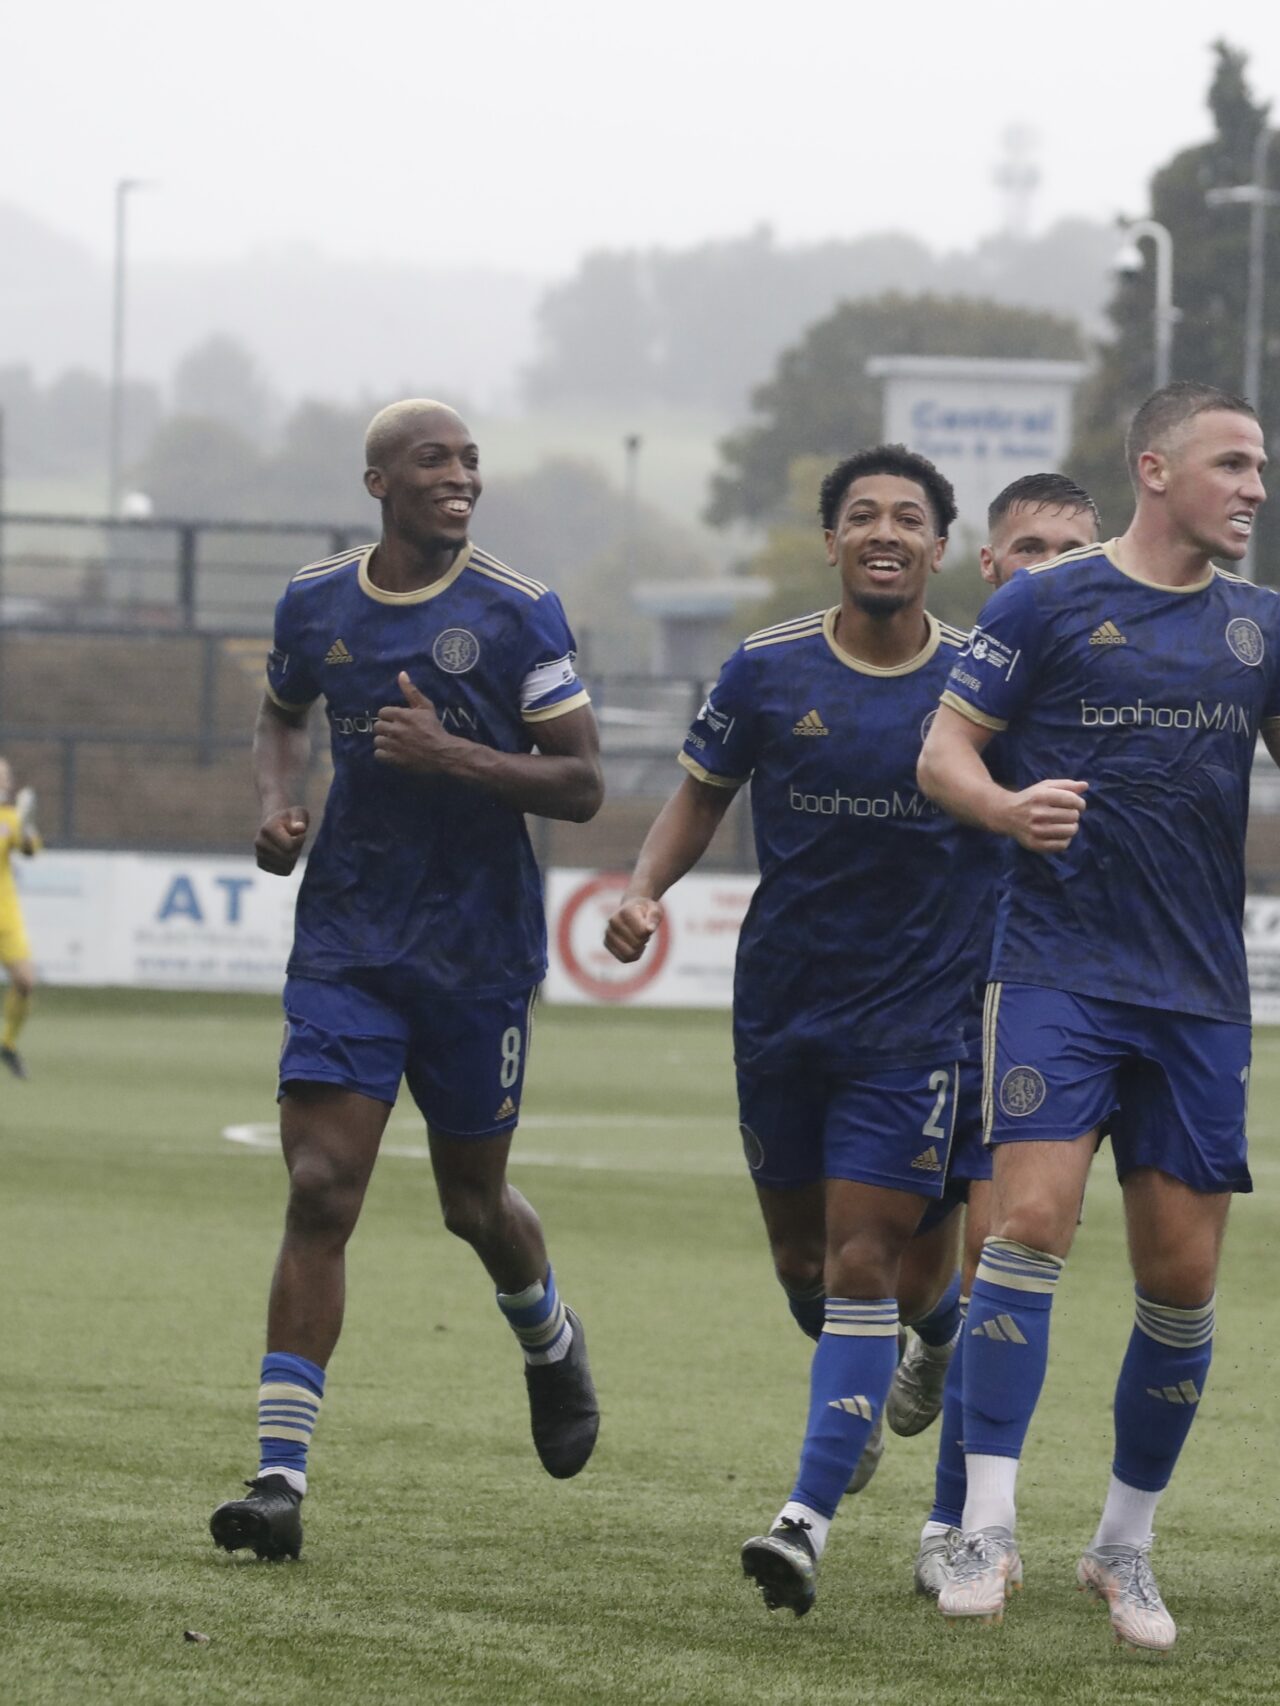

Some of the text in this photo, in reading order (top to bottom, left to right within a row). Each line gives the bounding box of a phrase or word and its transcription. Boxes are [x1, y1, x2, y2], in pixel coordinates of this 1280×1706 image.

[1089, 635, 1127, 645] adidas
[793, 727, 829, 736] adidas
[1081, 699, 1250, 738] boohooMAN
[156, 874, 254, 924] AT
[501, 1026, 521, 1089] 8
[922, 1070, 949, 1139] 2
